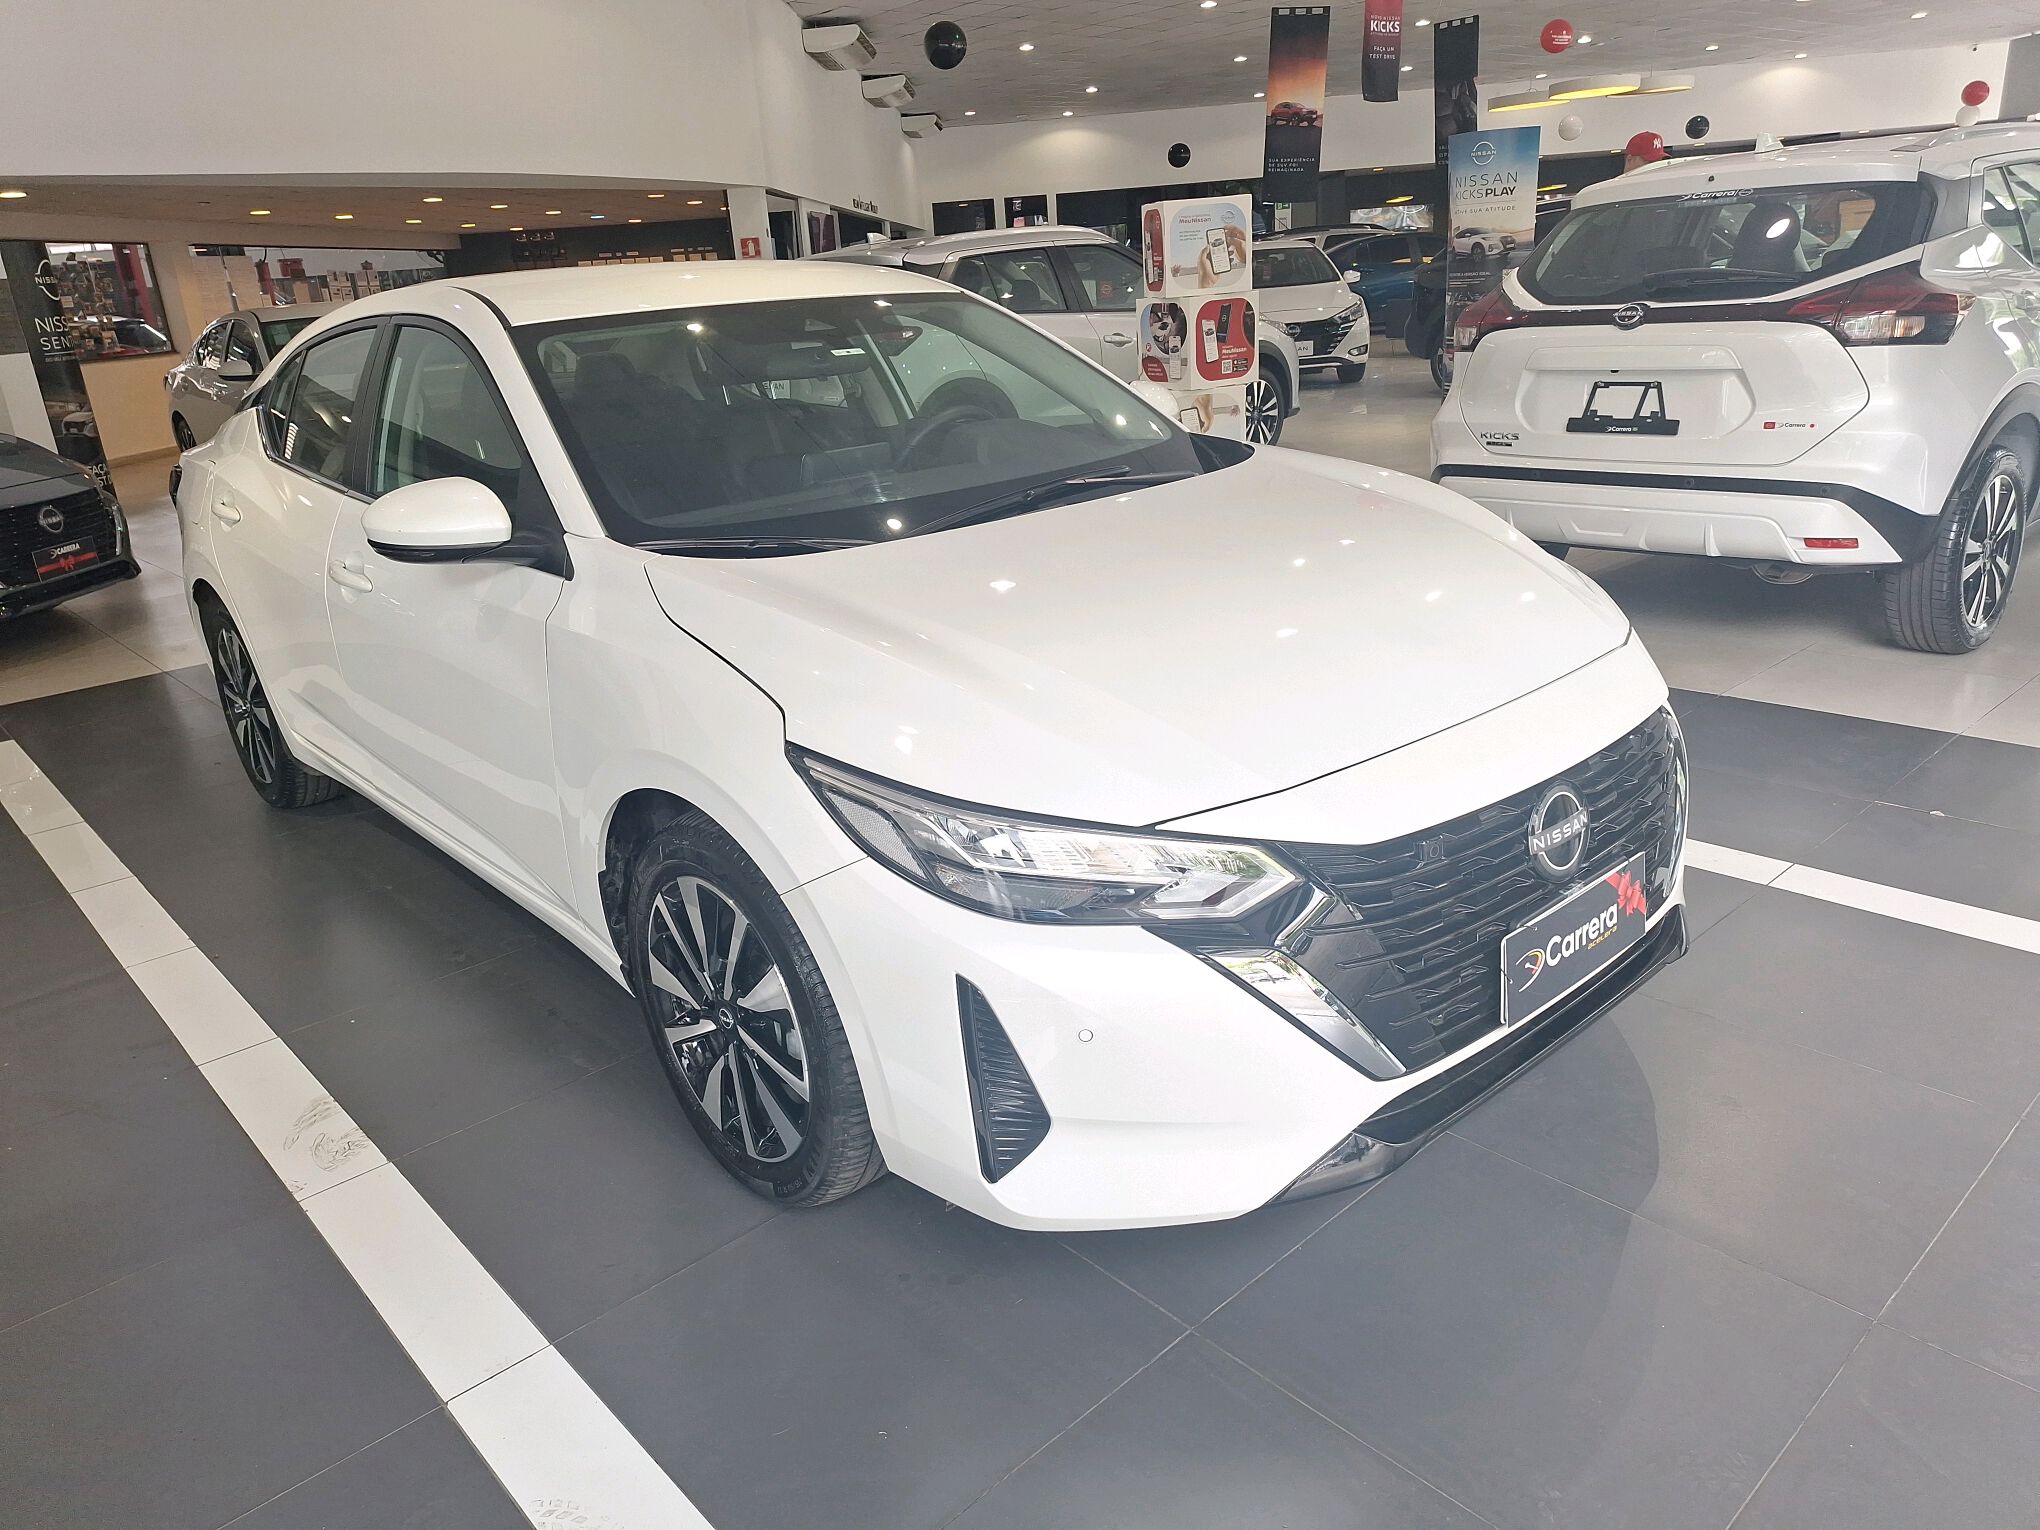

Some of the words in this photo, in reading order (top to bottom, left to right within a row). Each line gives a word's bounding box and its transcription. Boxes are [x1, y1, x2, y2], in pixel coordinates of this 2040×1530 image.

[1370, 19, 1400, 33] KICKS
[1470, 149, 1497, 158] NISSAN
[1455, 171, 1518, 189] NISSAN
[1692, 189, 1737, 199] Carrera
[1485, 205, 1516, 213] ATITUDE
[34, 316, 69, 334] NISS
[1480, 431, 1520, 441] KICKS
[56, 542, 81, 555] CARRERA
[1532, 810, 1588, 852] NISSAN
[1545, 903, 1618, 967] Carrera
[1587, 925, 1617, 950] acelera
